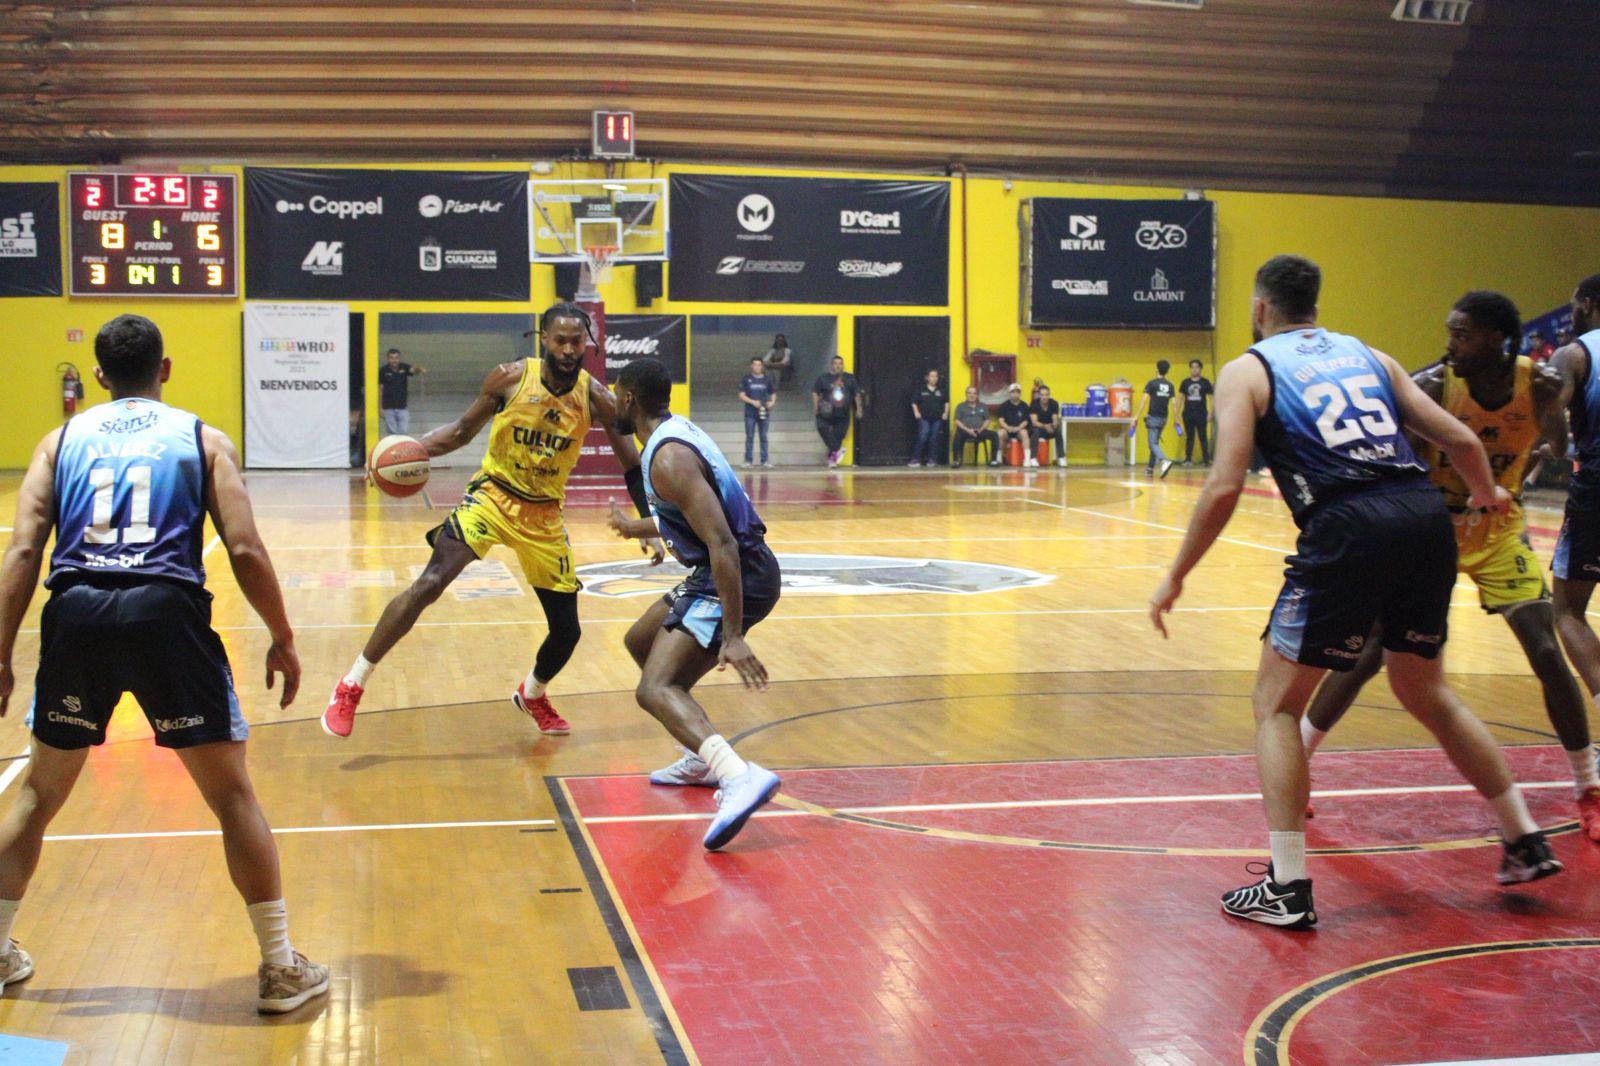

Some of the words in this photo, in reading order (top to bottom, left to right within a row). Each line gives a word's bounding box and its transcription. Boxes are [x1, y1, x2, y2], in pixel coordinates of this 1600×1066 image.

[608, 116, 630, 141] 11
[87, 187, 101, 206] 2
[204, 189, 218, 208] 2
[82, 210, 128, 221] GUEST
[309, 195, 383, 219] Coppel
[181, 212, 221, 223] HOME
[840, 210, 900, 228] D'Gari
[153, 220, 161, 240] 1
[1138, 227, 1185, 247] exa
[134, 241, 174, 251] PERIOD
[1060, 239, 1081, 251] NEW
[1081, 239, 1106, 252] PLAY
[90, 264, 106, 285] 3
[172, 265, 180, 286] 1
[207, 265, 222, 286] 3
[1133, 290, 1185, 302] CLAMONT
[296, 341, 329, 353] WRO
[260, 379, 338, 391] BIENVENIDOS
[1302, 374, 1398, 448] 25
[82, 465, 157, 544] 11
[558, 555, 570, 575] 11
[47, 711, 99, 732] Cinemex
